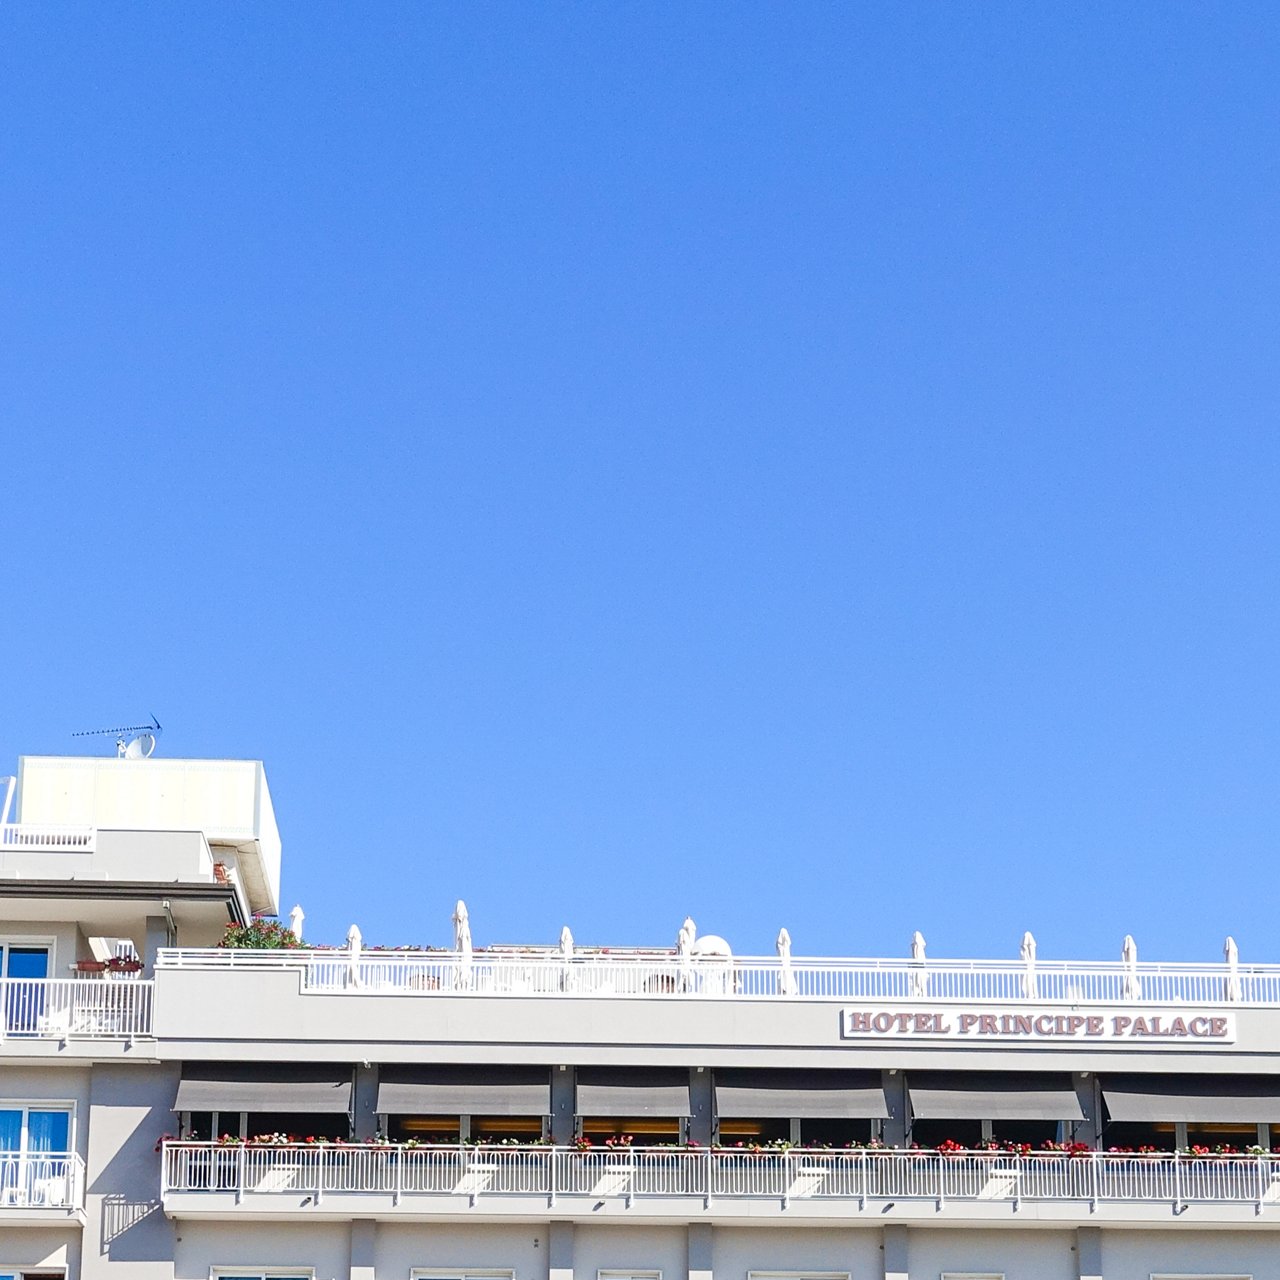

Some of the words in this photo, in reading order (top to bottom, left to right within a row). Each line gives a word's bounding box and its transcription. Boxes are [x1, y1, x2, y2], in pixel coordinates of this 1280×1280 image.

[849, 1012, 951, 1035] HOTEL
[958, 1014, 1105, 1037] PRINCIPE
[1112, 1016, 1228, 1038] PALACE
